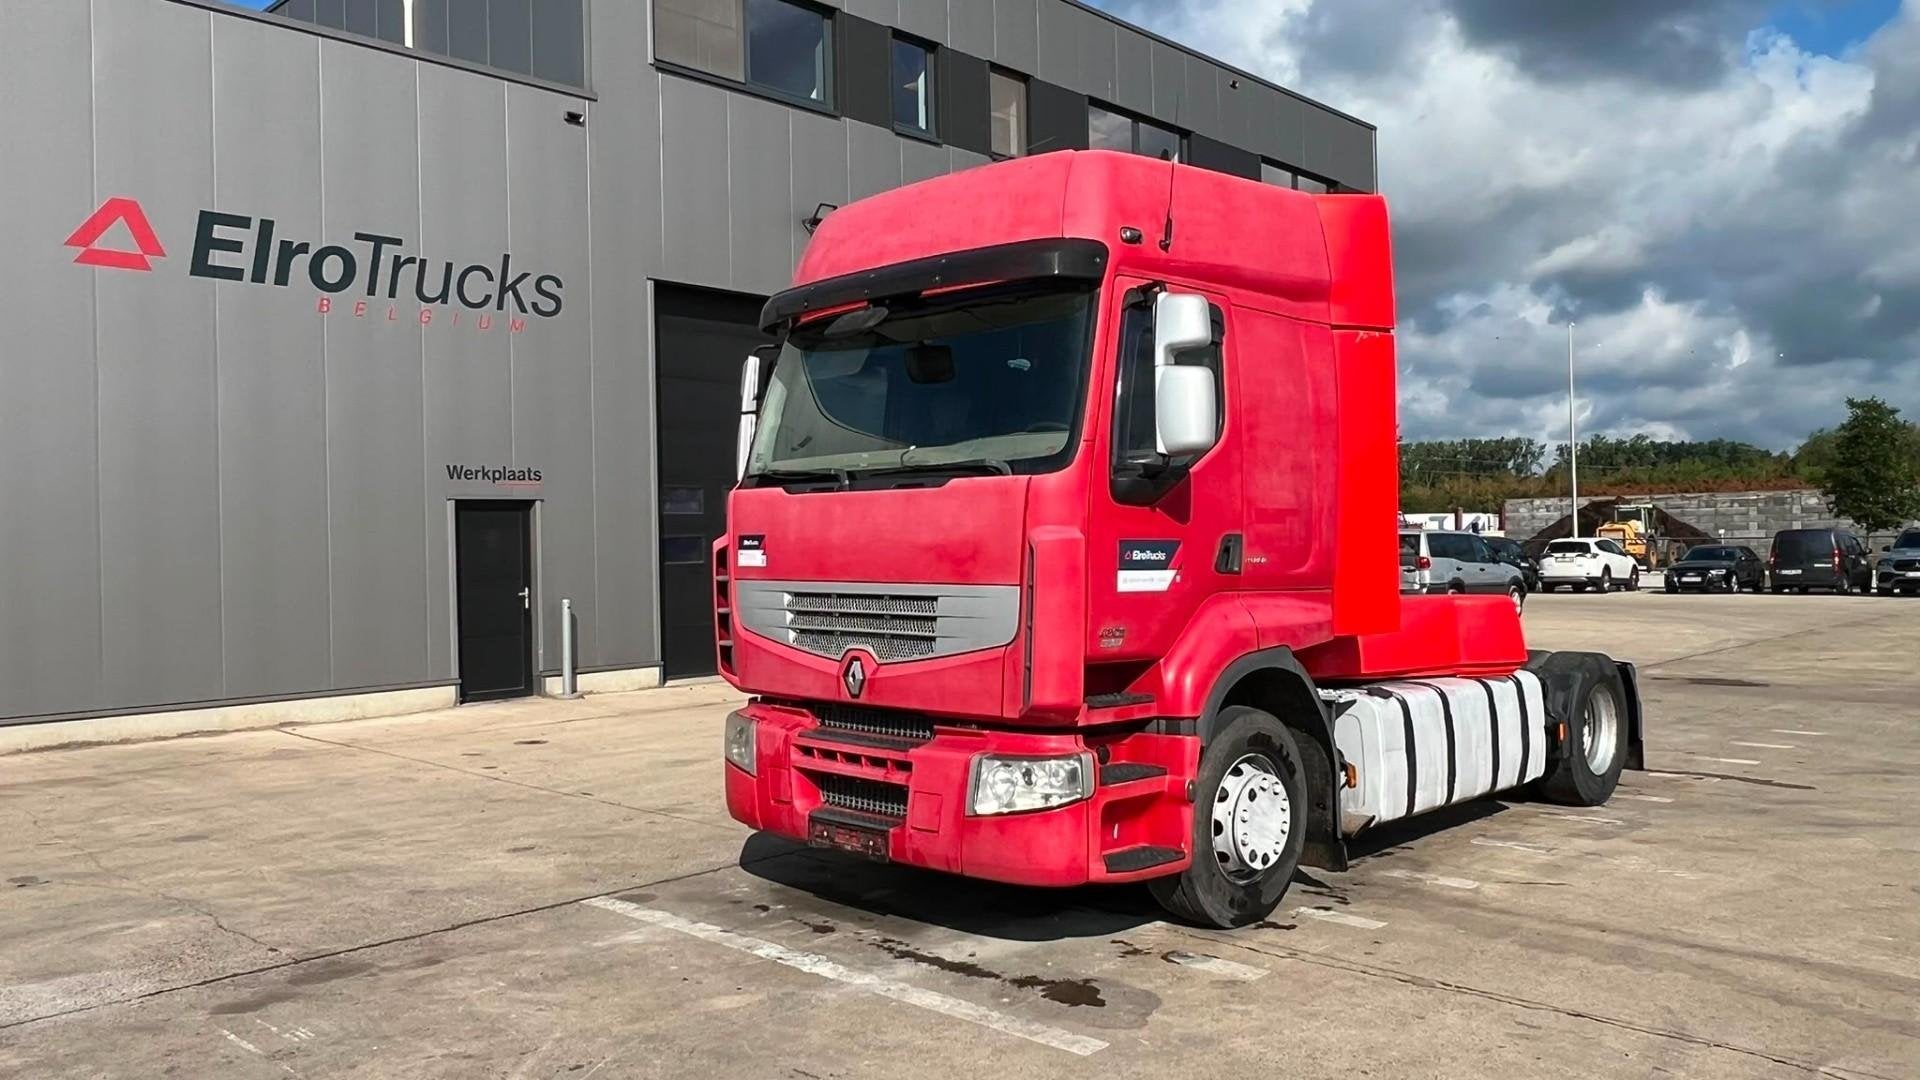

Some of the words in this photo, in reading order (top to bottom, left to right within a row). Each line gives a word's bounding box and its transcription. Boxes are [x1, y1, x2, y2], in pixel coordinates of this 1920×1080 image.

[190, 210, 563, 318] ElroTrucks
[317, 298, 526, 333] BELGIUM
[446, 465, 542, 483] Werkplaats
[1132, 550, 1166, 560] ElroTrucks
